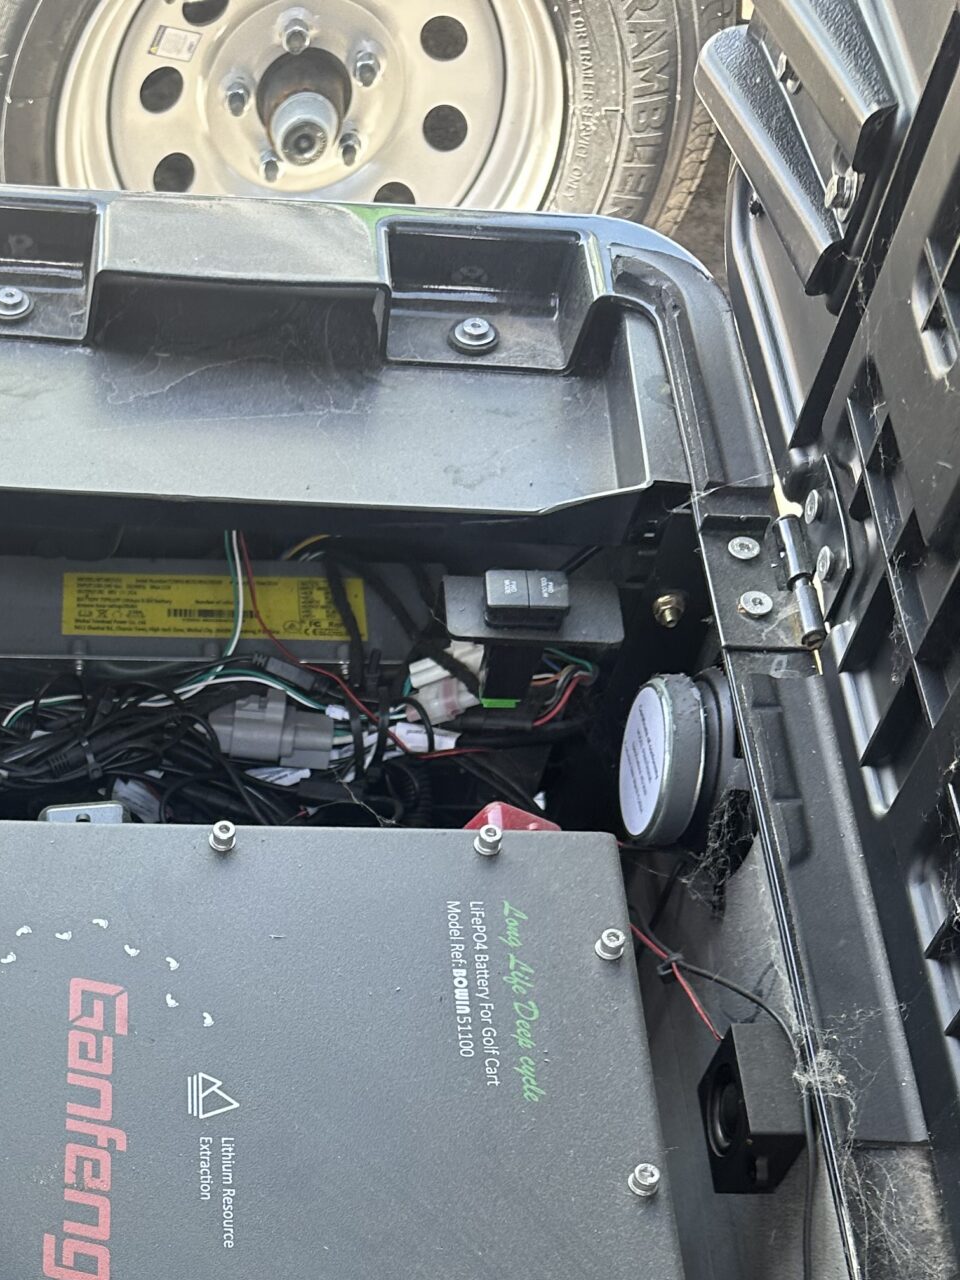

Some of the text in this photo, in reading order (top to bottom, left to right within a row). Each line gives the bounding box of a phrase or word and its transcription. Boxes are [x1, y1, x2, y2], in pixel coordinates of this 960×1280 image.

[579, 43, 596, 101] TRAILER
[574, 105, 594, 160] SERVICE
[563, 166, 585, 203] ONLY
[447, 901, 464, 939] Model
[470, 902, 501, 1086] LiFePO4 Battery For Golf Cart
[499, 901, 546, 1102] Long Life Deep cycle
[199, 1136, 215, 1201] Extraction
[220, 1136, 237, 1249] Lithium Resource
